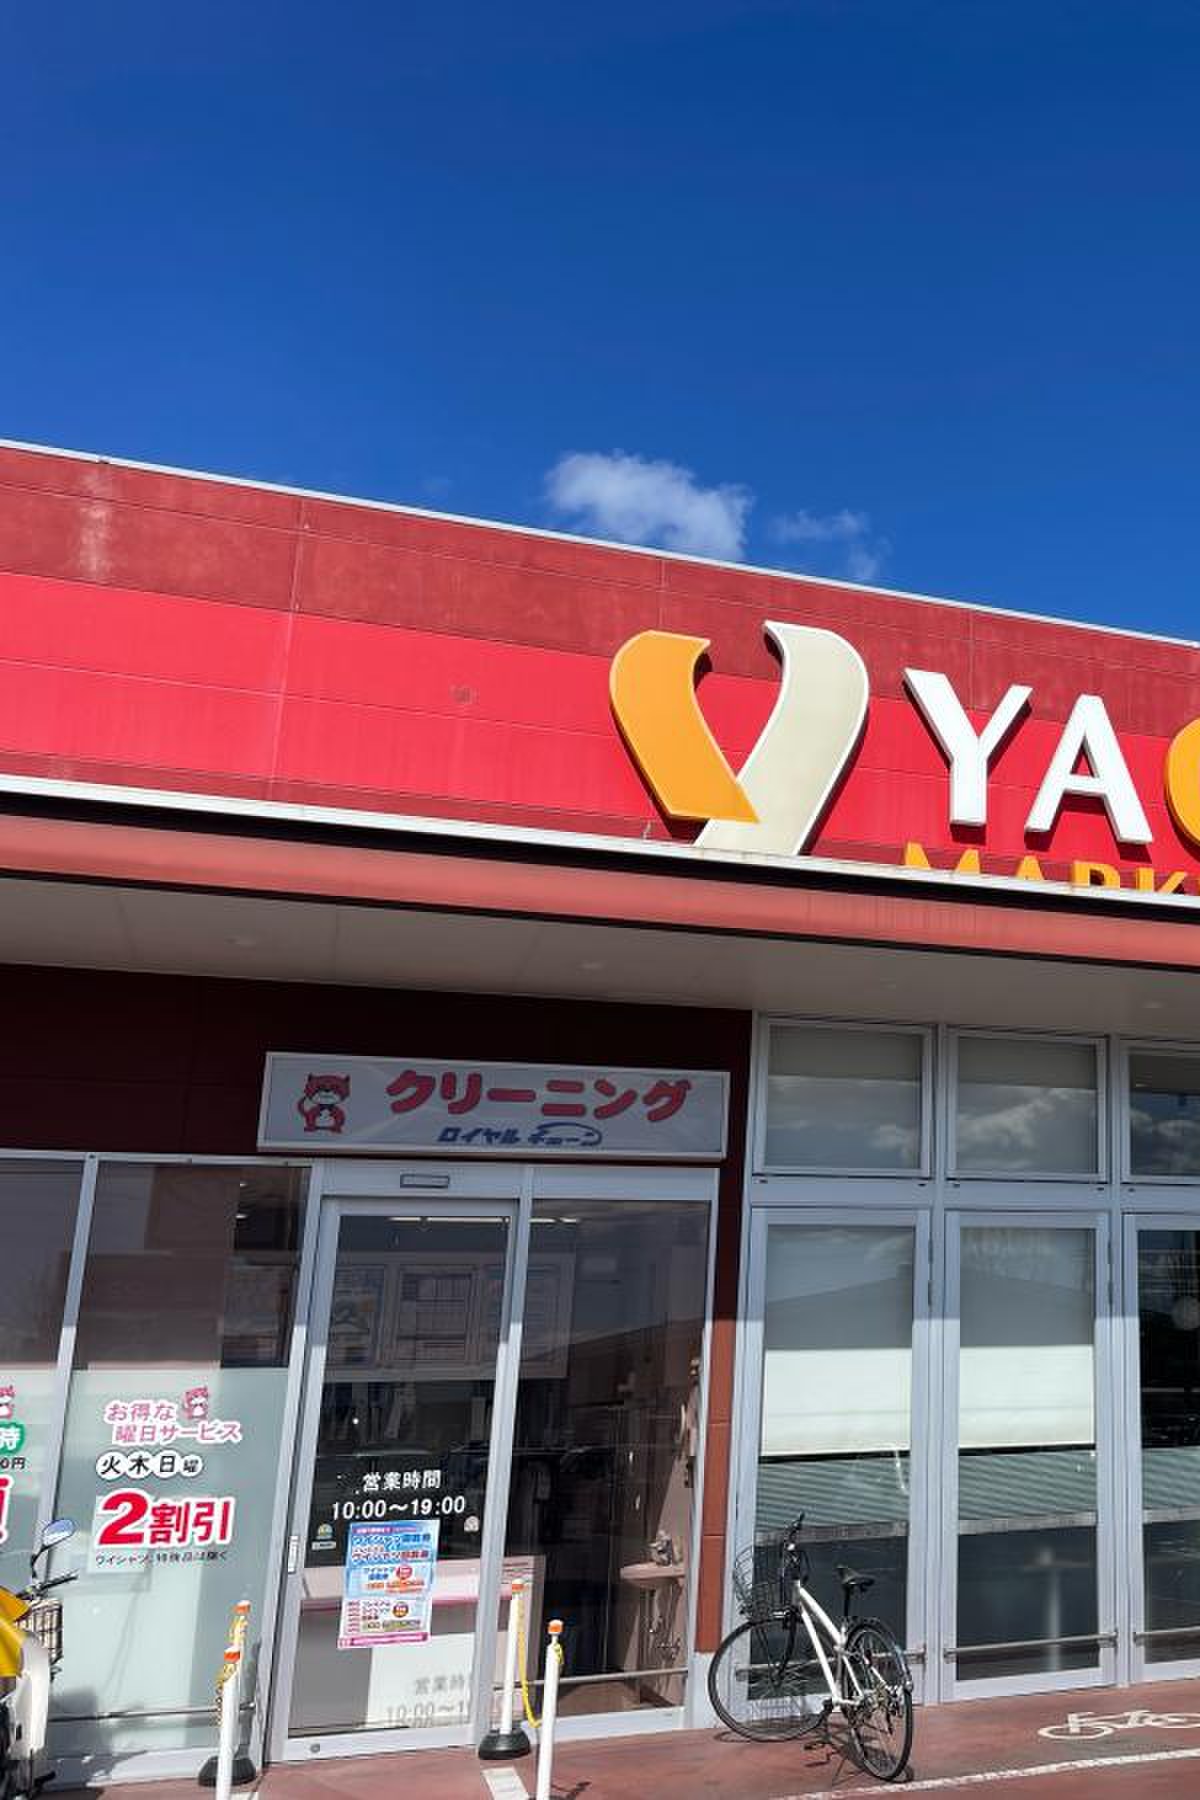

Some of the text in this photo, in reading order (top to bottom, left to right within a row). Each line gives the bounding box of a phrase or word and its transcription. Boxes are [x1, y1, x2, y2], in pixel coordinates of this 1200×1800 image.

[386, 1069, 693, 1123] クリーニング
[106, 1402, 175, 1422] お得な
[115, 1423, 240, 1443] 曜日サービス
[362, 1469, 442, 1492] 営業時間
[98, 1491, 231, 1546] 2割引
[332, 1495, 466, 1521] 10:00～19:00
